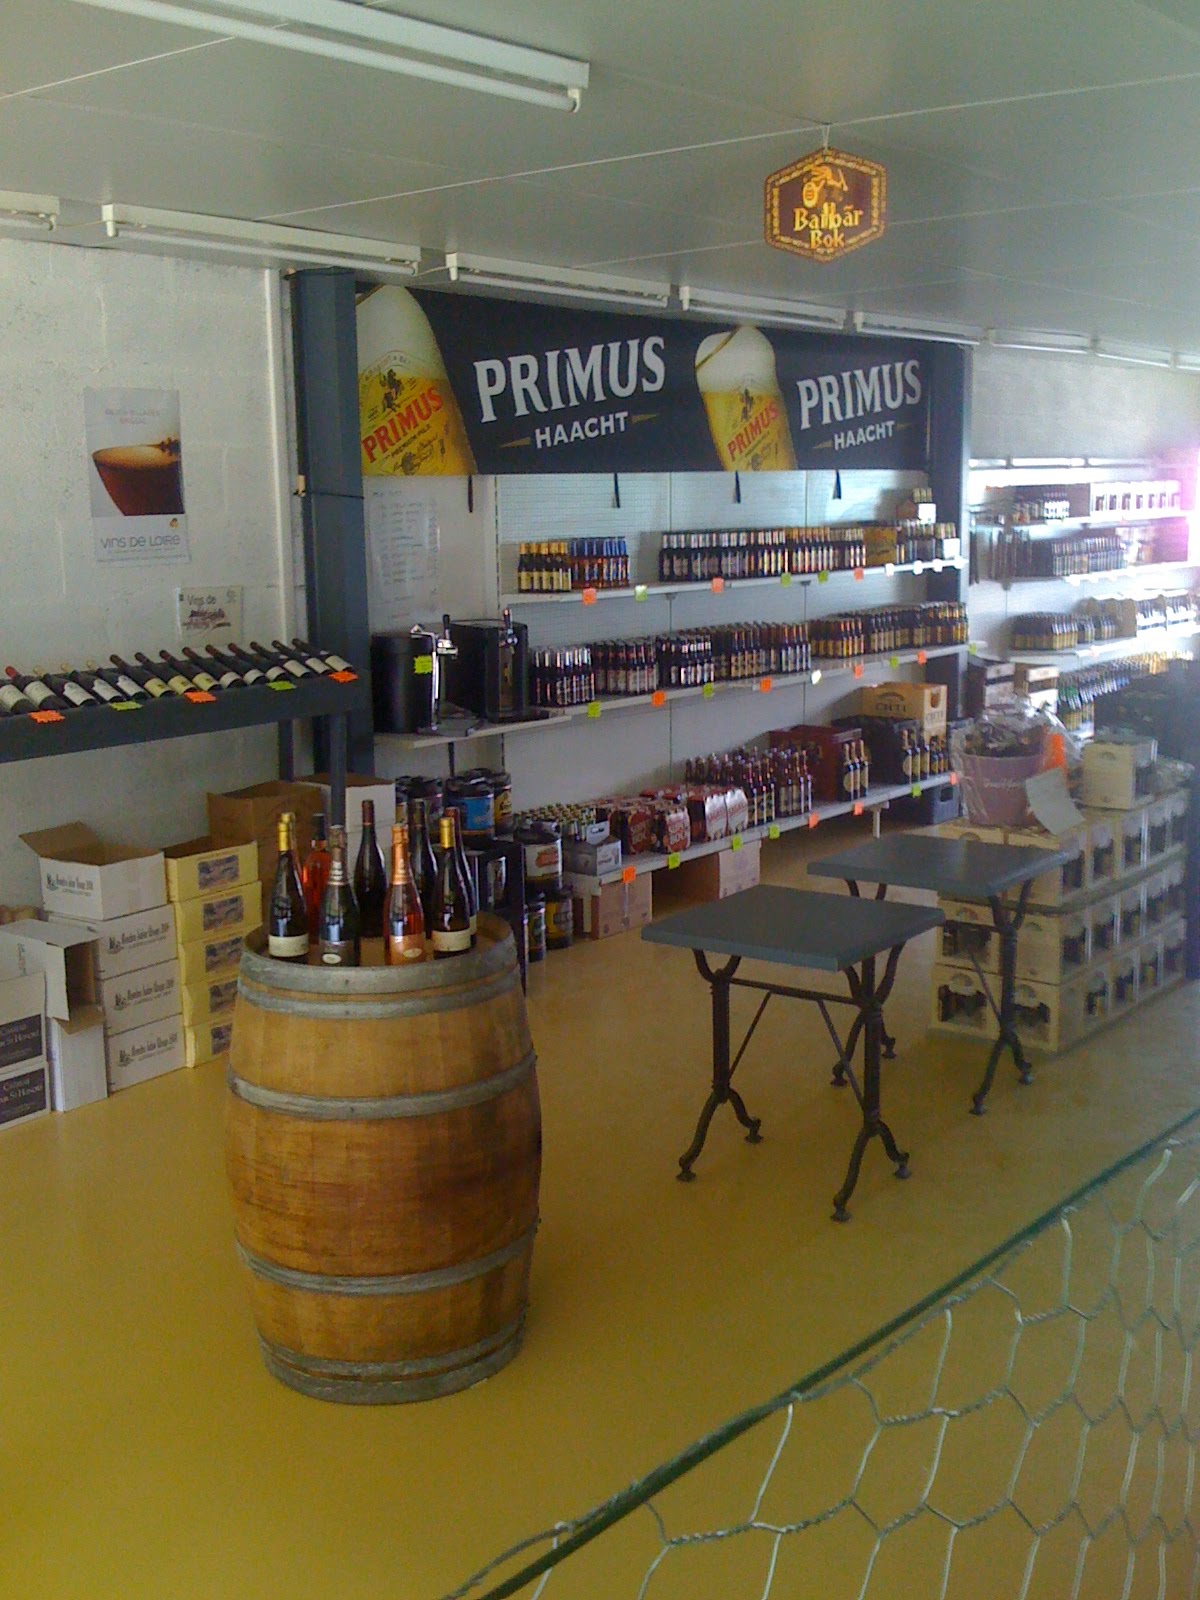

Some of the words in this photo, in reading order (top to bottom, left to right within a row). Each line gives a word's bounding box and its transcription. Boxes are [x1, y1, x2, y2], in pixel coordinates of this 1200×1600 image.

[810, 229, 845, 249] Bok
[473, 336, 666, 424] PRIMUS
[796, 359, 922, 430] PRIMUS
[361, 385, 443, 463] PRIMUS
[534, 411, 629, 449] HAACHT
[727, 399, 779, 463] PRIMUS
[834, 421, 895, 450] HAACHT
